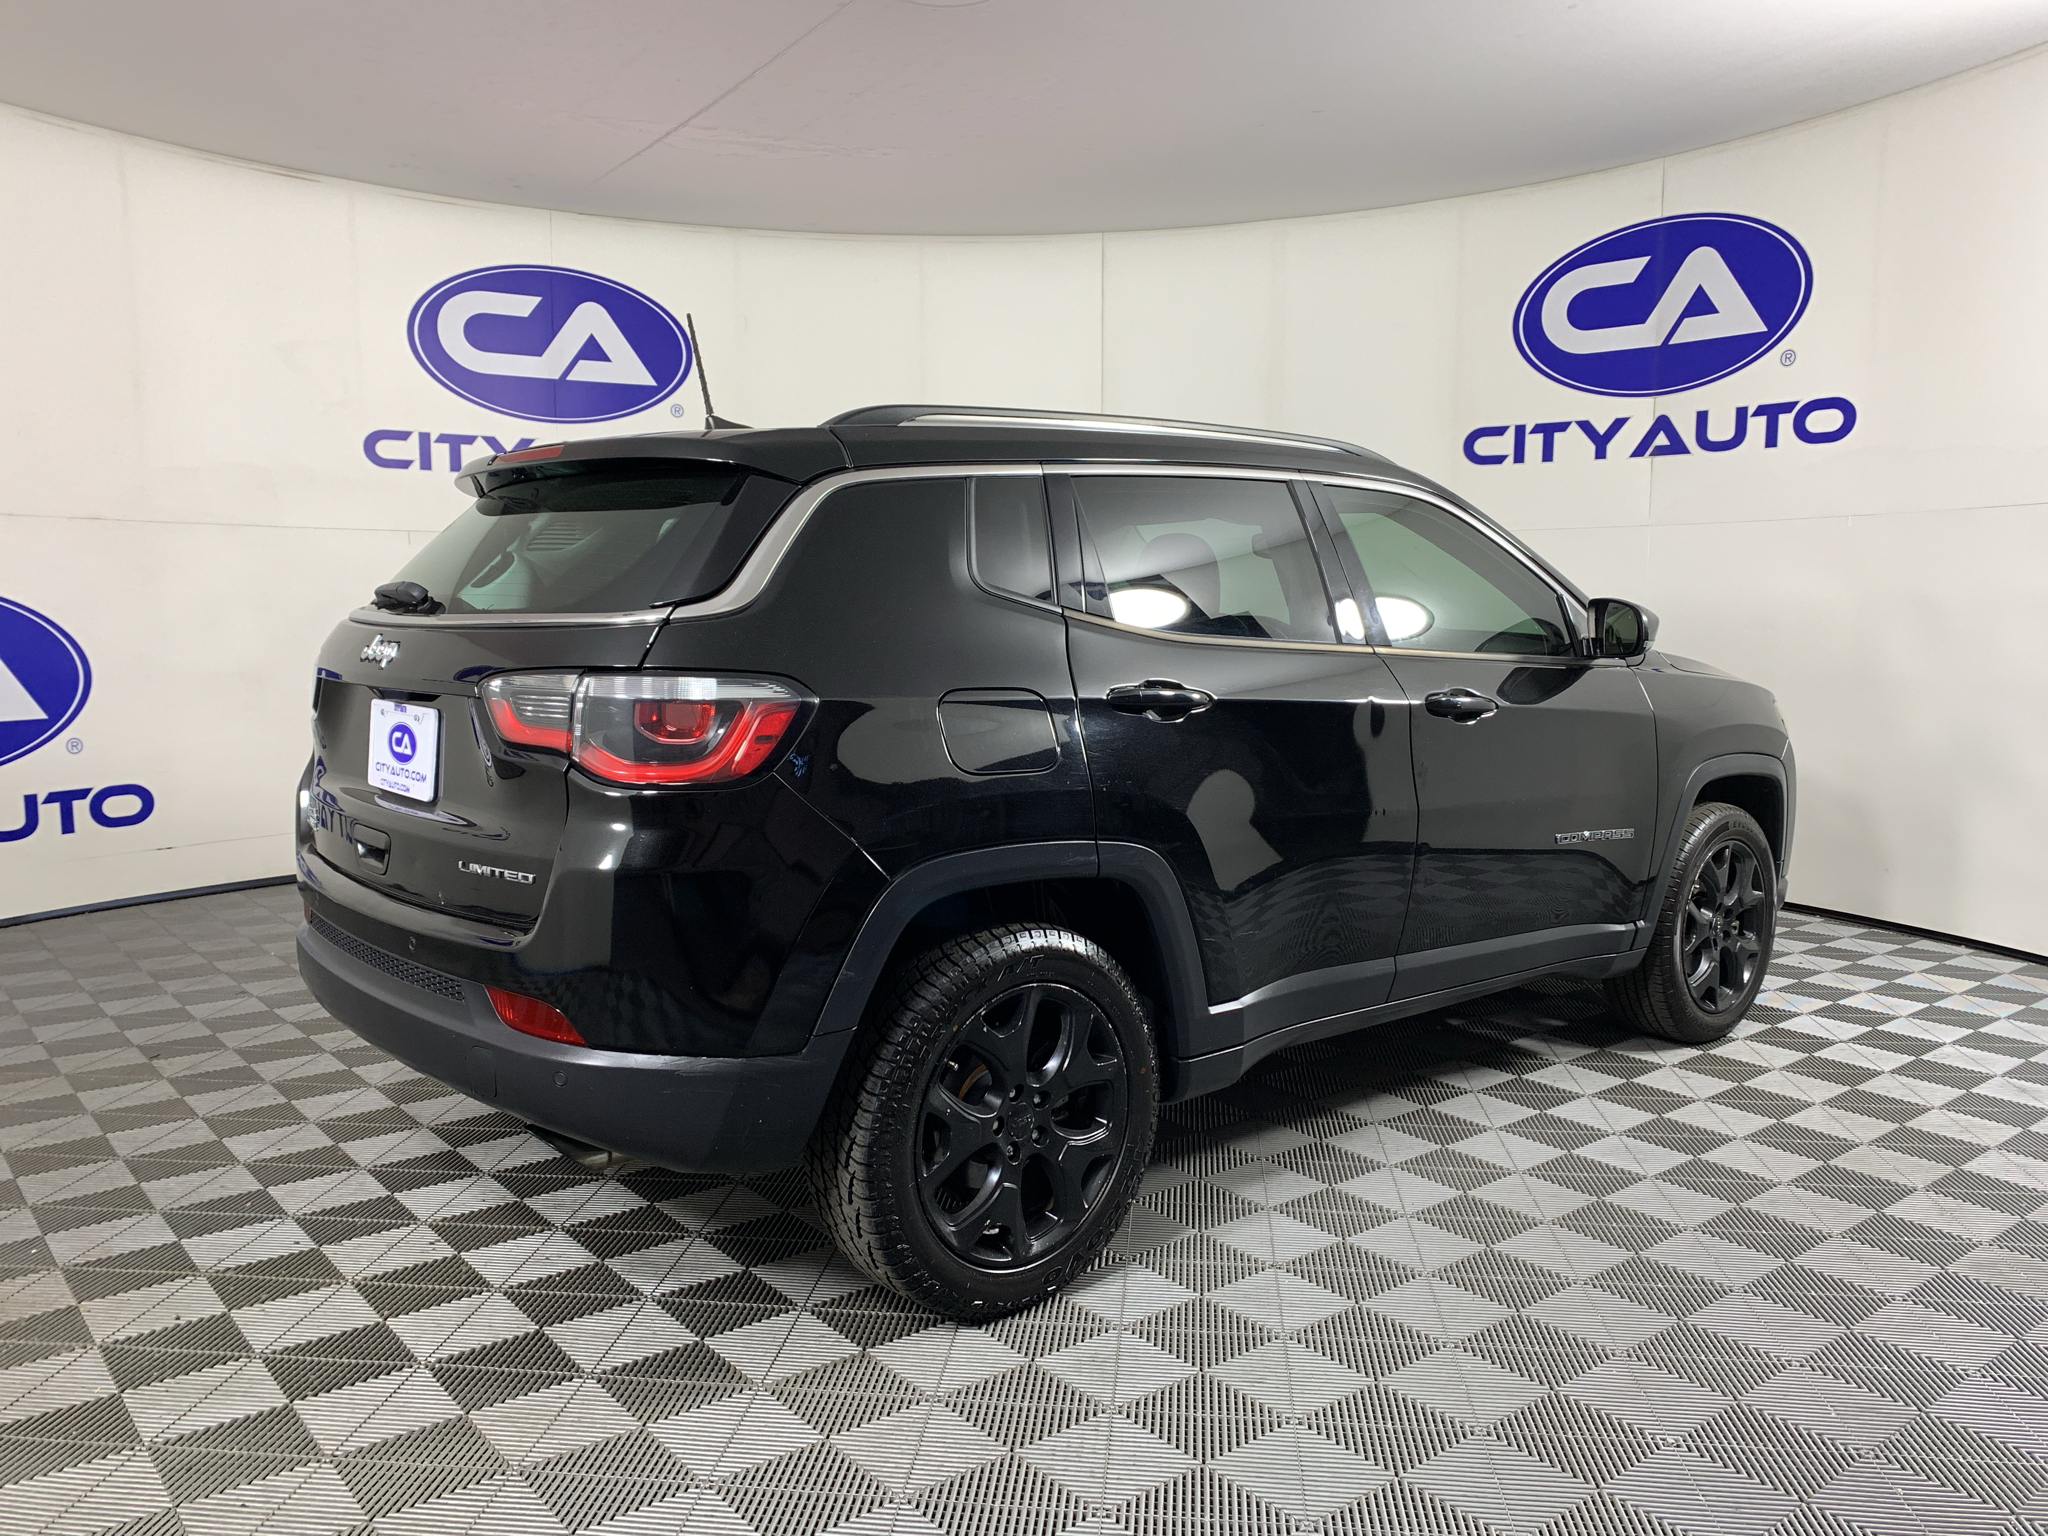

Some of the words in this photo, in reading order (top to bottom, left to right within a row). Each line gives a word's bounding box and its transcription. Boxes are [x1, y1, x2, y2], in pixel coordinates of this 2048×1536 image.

[1541, 246, 1768, 354] CA
[437, 290, 658, 386] CA
[360, 633, 400, 670] Jeep
[391, 731, 412, 756] CA
[376, 761, 427, 783] CITYAUTO.COM
[1555, 828, 1634, 845] COMPASS
[458, 860, 536, 885] LIMITED
[997, 954, 1045, 982] A/T
